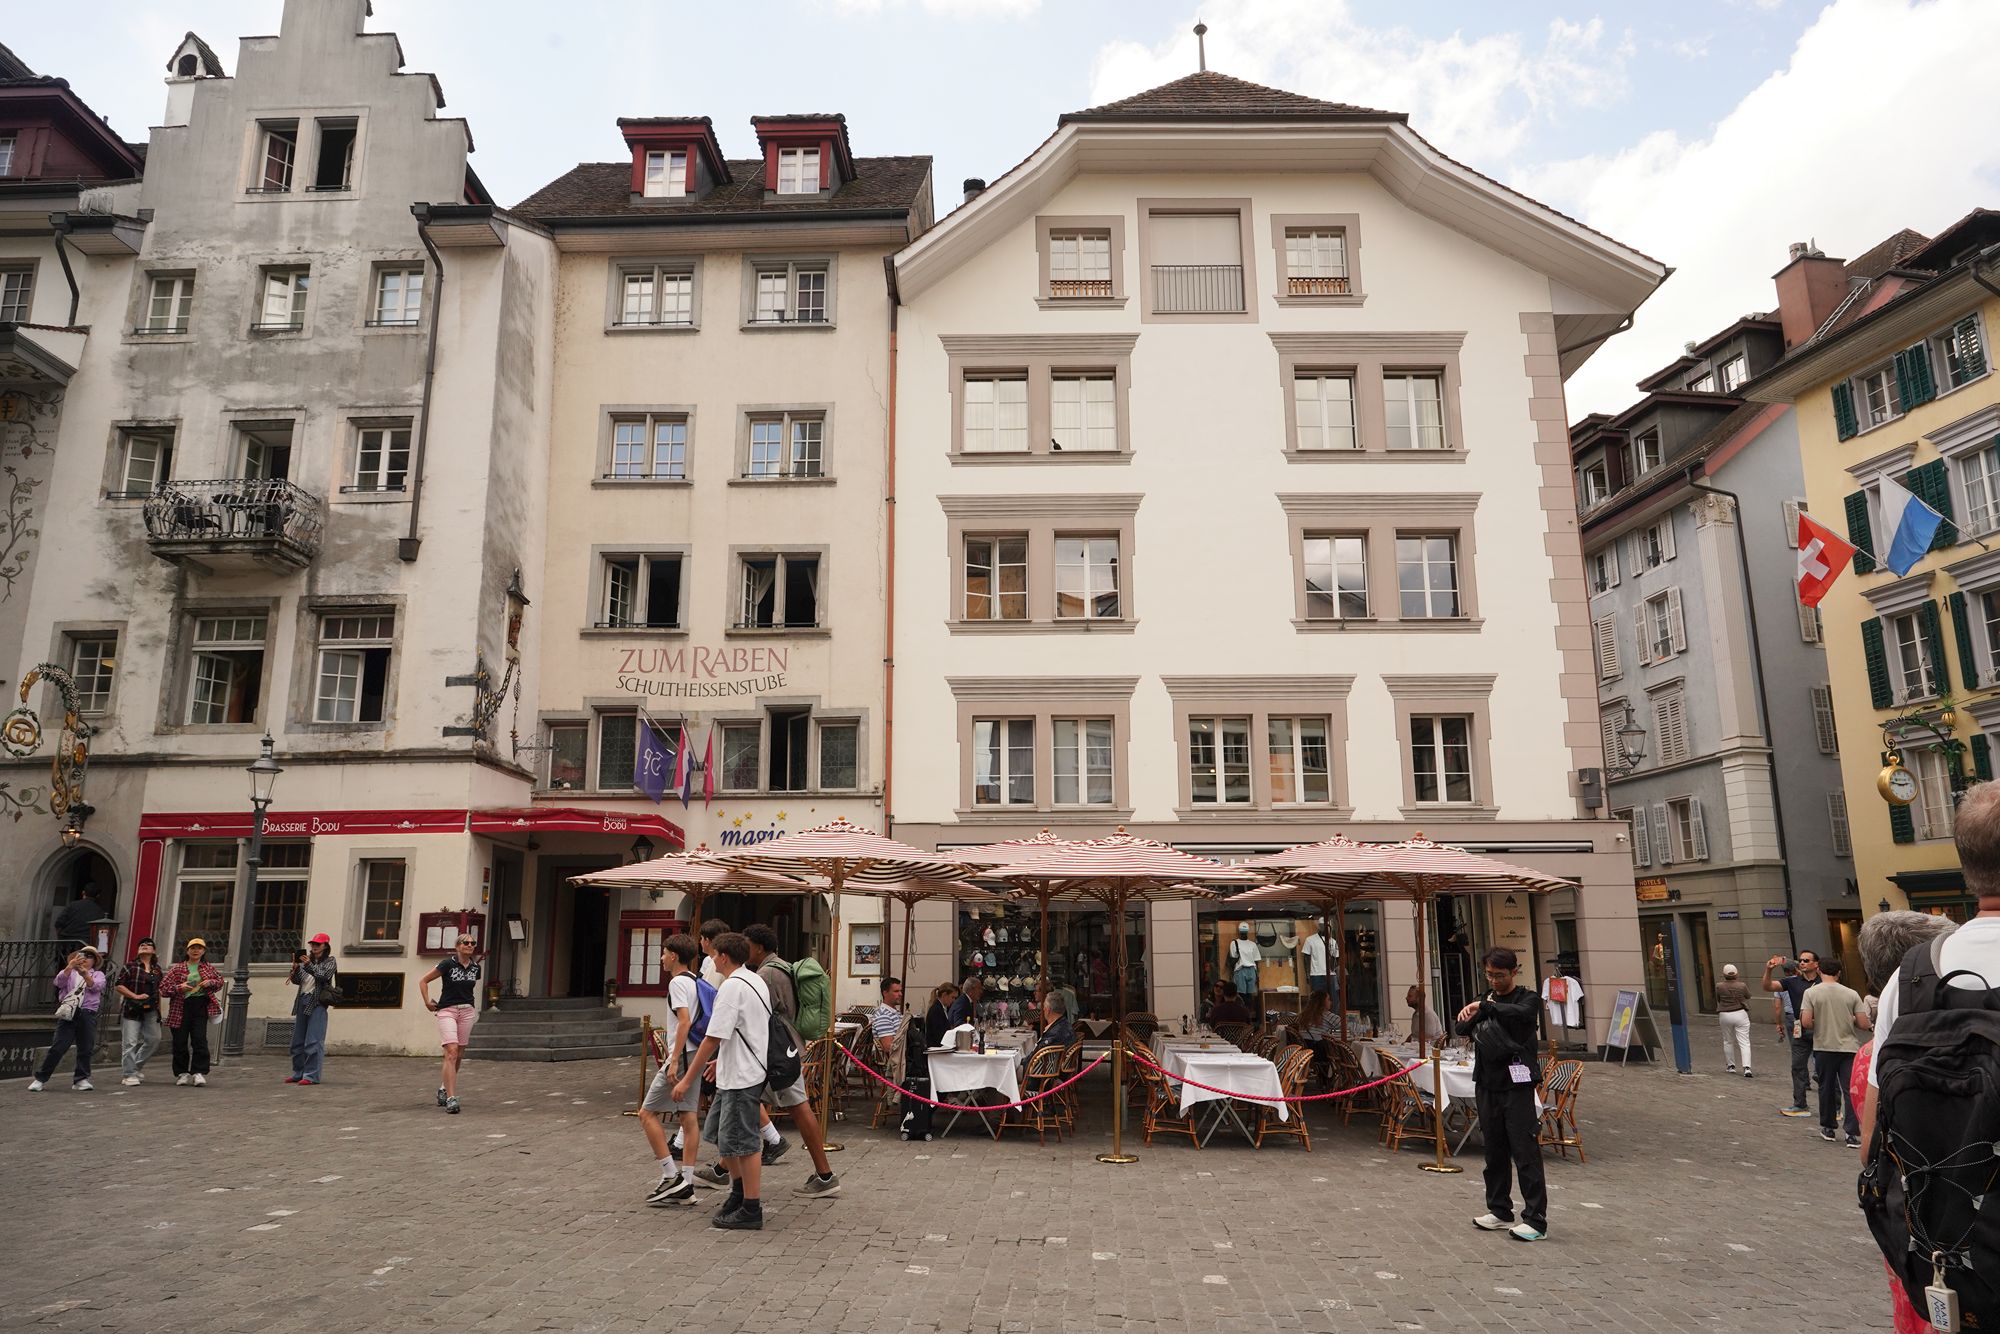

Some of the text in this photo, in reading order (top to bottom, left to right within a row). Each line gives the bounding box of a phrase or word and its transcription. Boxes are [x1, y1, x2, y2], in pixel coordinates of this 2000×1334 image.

[617, 646, 789, 679] ZUM RABEN
[615, 672, 788, 698] SCHULTHEISSENSTUBE
[310, 816, 340, 834] BODU
[602, 816, 627, 831] BODU
[1639, 878, 1661, 887] HOTELS
